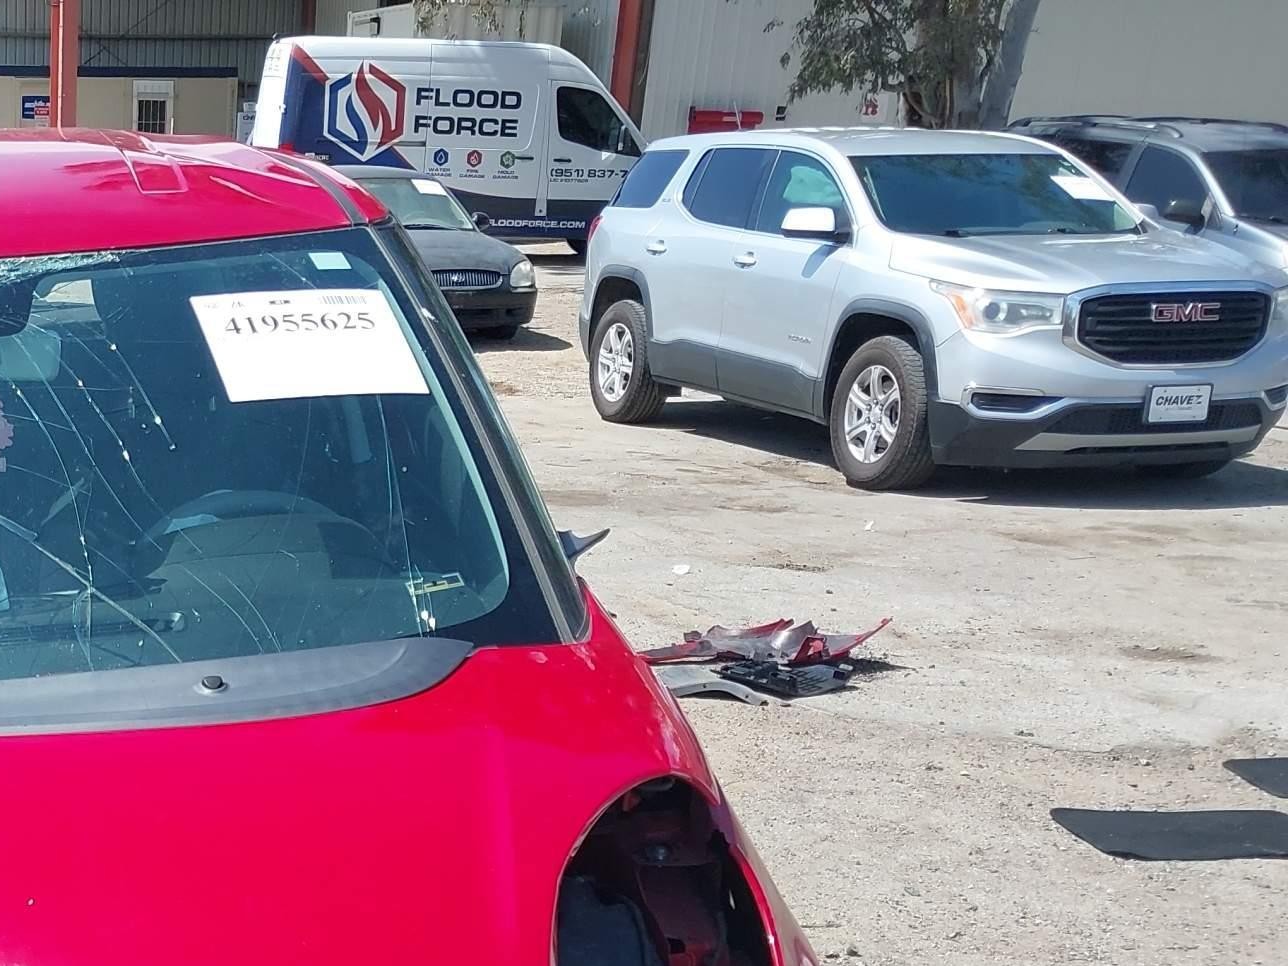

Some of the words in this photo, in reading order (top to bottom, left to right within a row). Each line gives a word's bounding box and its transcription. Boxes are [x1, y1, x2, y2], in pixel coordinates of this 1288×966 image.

[415, 87, 522, 109] FLOOD
[413, 115, 518, 138] FORCE
[550, 168, 584, 178] (951)
[1151, 302, 1221, 322] GMC
[224, 311, 376, 336] 41955625
[1155, 394, 1203, 406] CHAVEZ
